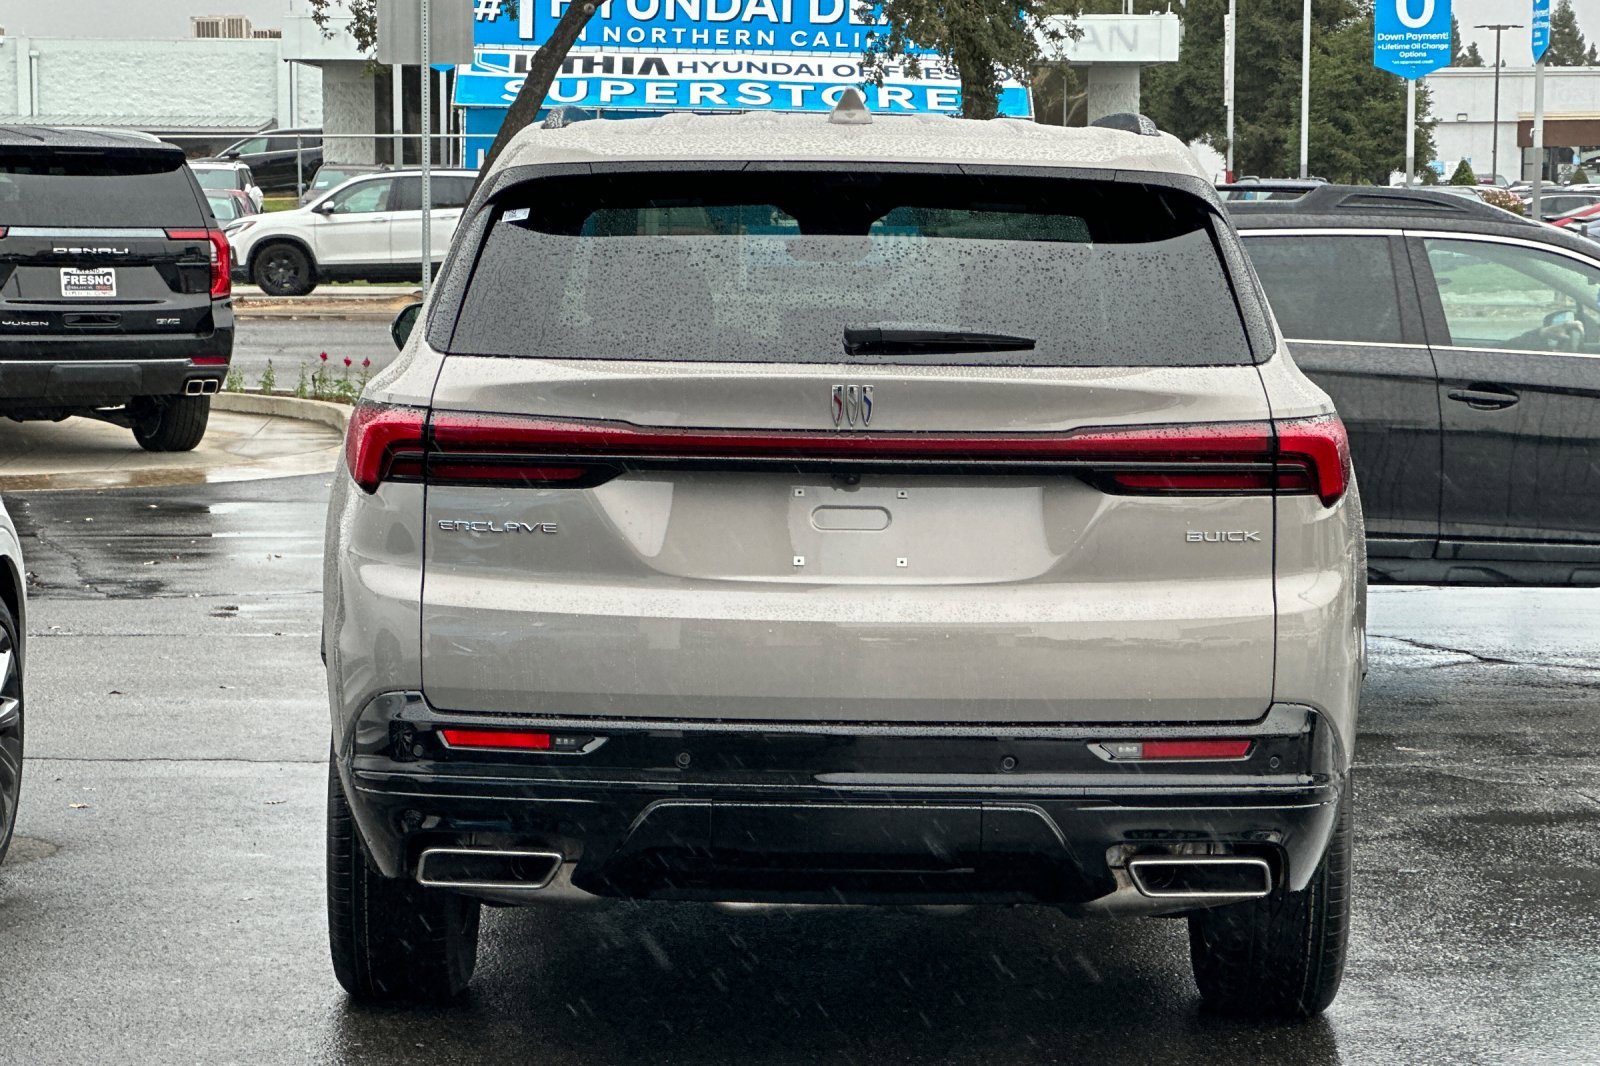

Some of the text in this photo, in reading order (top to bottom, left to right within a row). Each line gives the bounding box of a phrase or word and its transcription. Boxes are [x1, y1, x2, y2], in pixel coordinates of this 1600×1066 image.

[603, 26, 775, 47] NORTHERN
[1377, 33, 1405, 41] Down
[1421, 43, 1449, 51] Change
[514, 54, 670, 76] LTHIA
[676, 60, 824, 77] HYUNDAI
[501, 79, 964, 111] SUPERSTORE
[63, 275, 113, 285] FRESNO
[437, 519, 558, 534] ENCLAVE
[1185, 530, 1262, 542] BUICK
